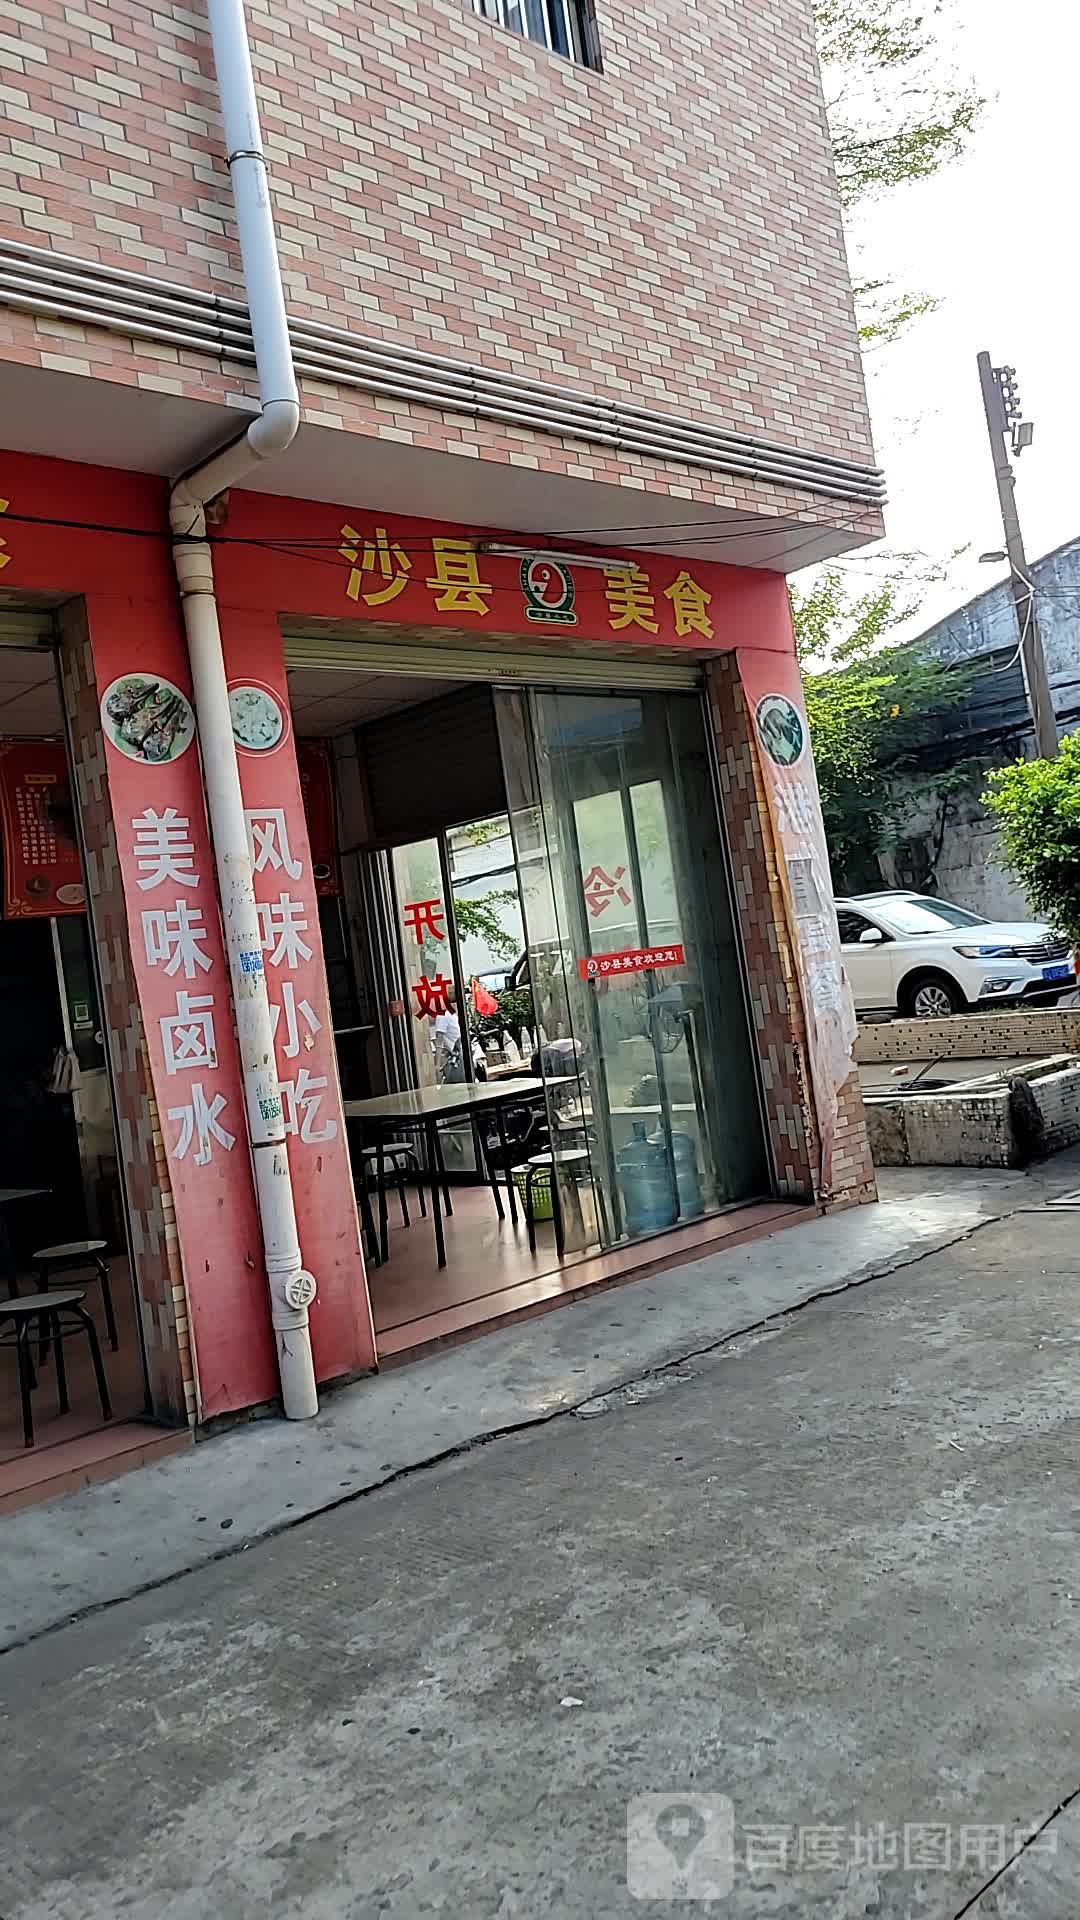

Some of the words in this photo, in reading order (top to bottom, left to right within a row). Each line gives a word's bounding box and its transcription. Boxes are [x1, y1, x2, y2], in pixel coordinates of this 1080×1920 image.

[338, 524, 494, 616] 沙县
[603, 562, 716, 639] 美食
[131, 807, 236, 1167] 美味卤水
[242, 808, 338, 1144] 风味小吃
